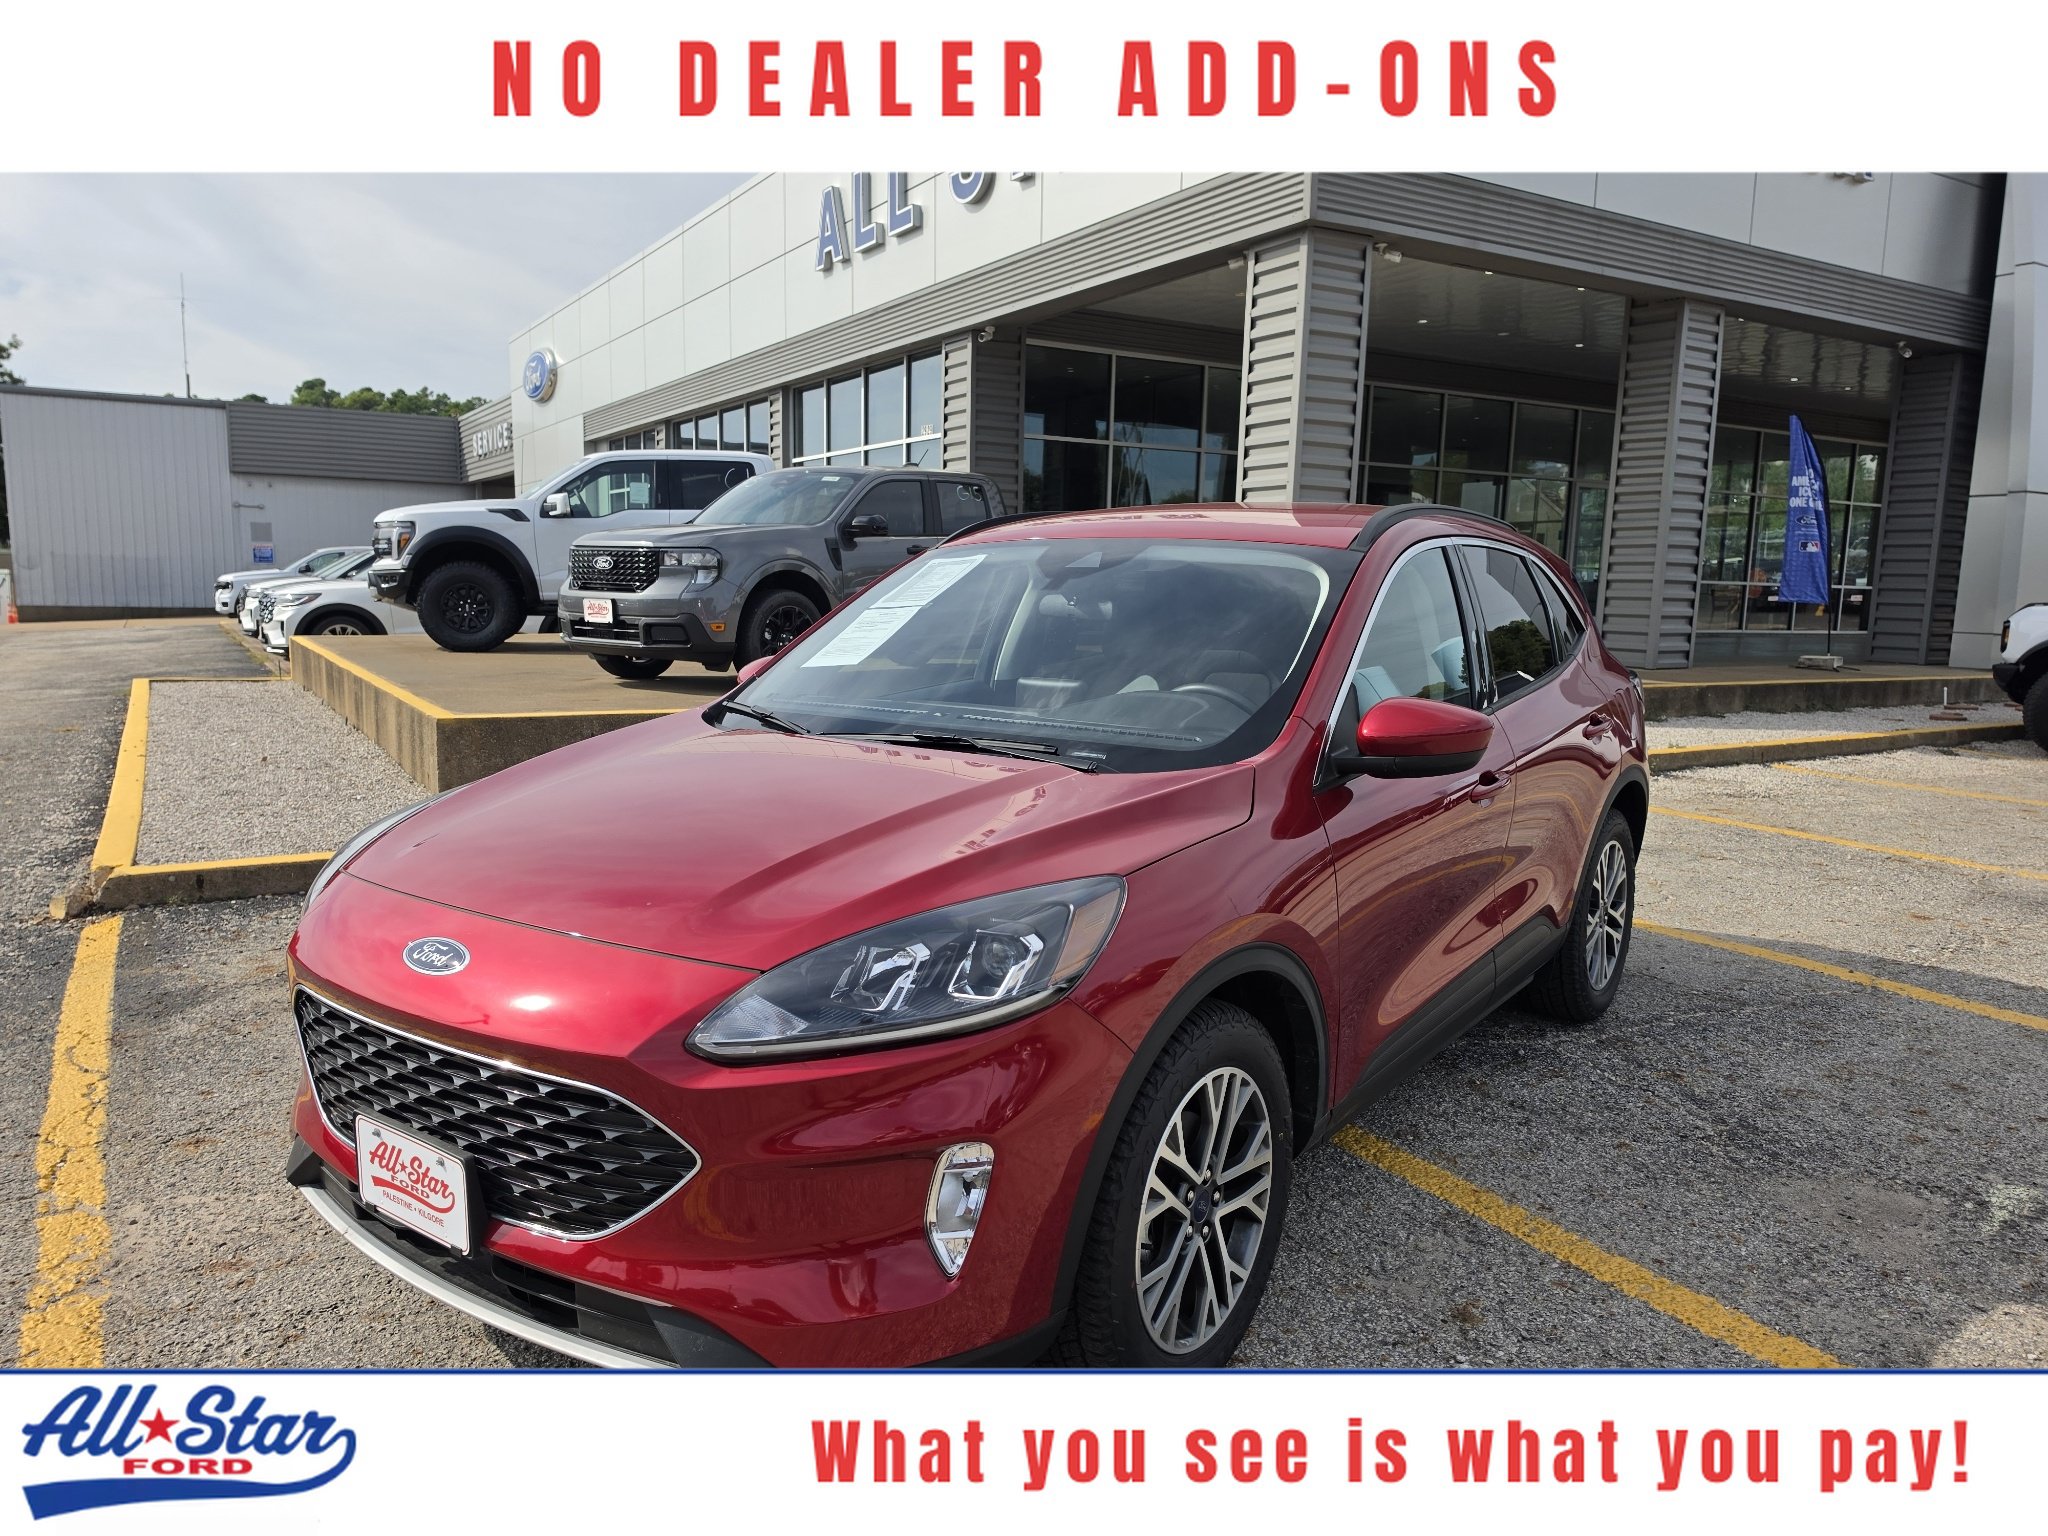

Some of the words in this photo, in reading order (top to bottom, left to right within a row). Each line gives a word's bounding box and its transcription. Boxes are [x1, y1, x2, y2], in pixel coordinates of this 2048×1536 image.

[816, 172, 919, 272] ALL
[473, 422, 509, 457] SERVICE
[1790, 498, 1807, 507] ONE
[412, 942, 454, 966] Ford
[369, 1141, 402, 1175] All
[407, 1156, 452, 1199] Star
[391, 1174, 430, 1199] FORD
[382, 1189, 413, 1212] PALESTINE
[418, 1207, 445, 1228] KILGORE
